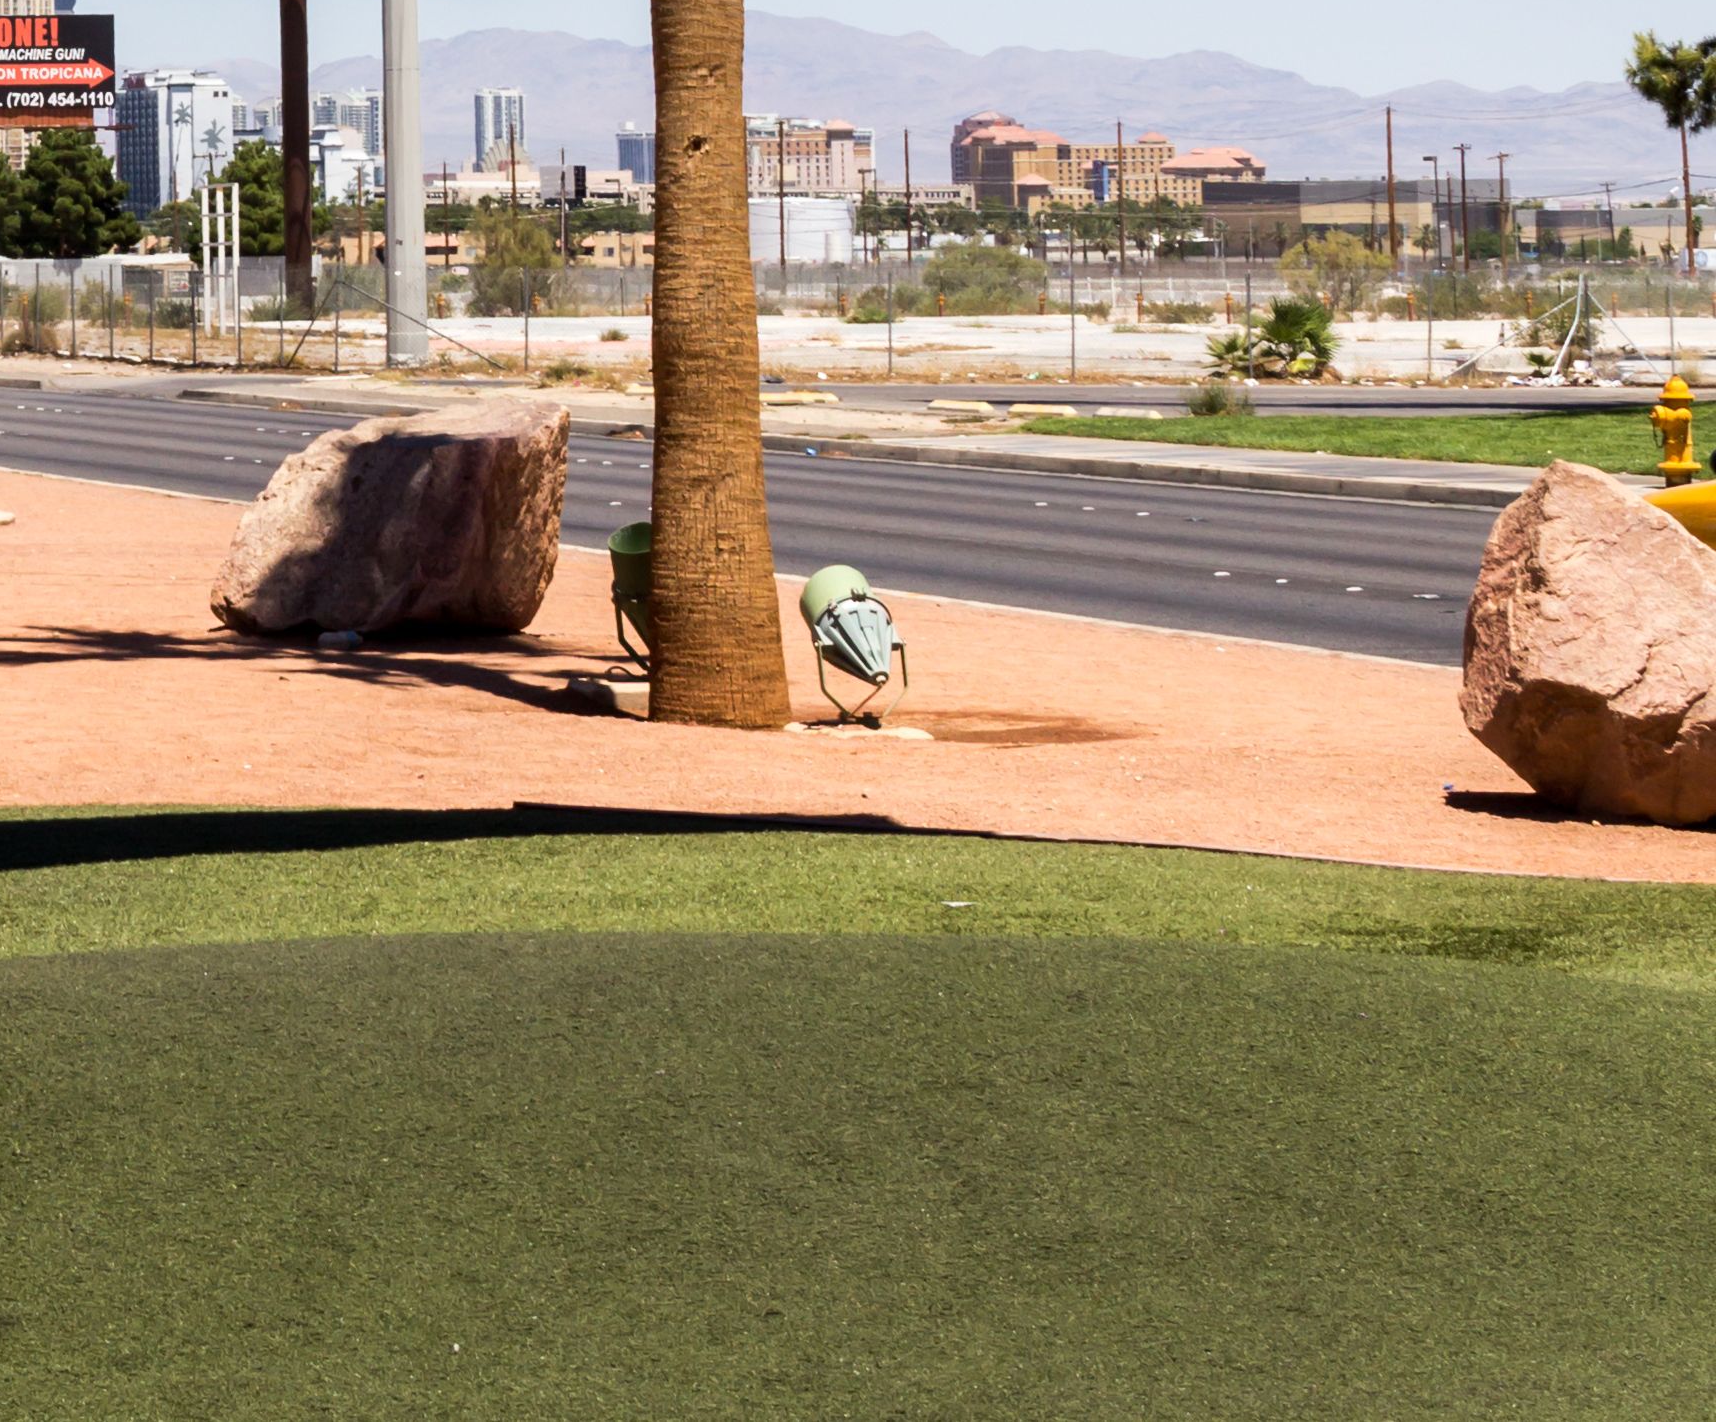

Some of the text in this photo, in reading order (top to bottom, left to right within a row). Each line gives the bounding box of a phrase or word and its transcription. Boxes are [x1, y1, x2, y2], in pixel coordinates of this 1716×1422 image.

[55, 48, 85, 60] GUN!
[20, 67, 104, 80] TROPICANA
[6, 92, 44, 108] (702)
[48, 91, 114, 106] 454-1110
